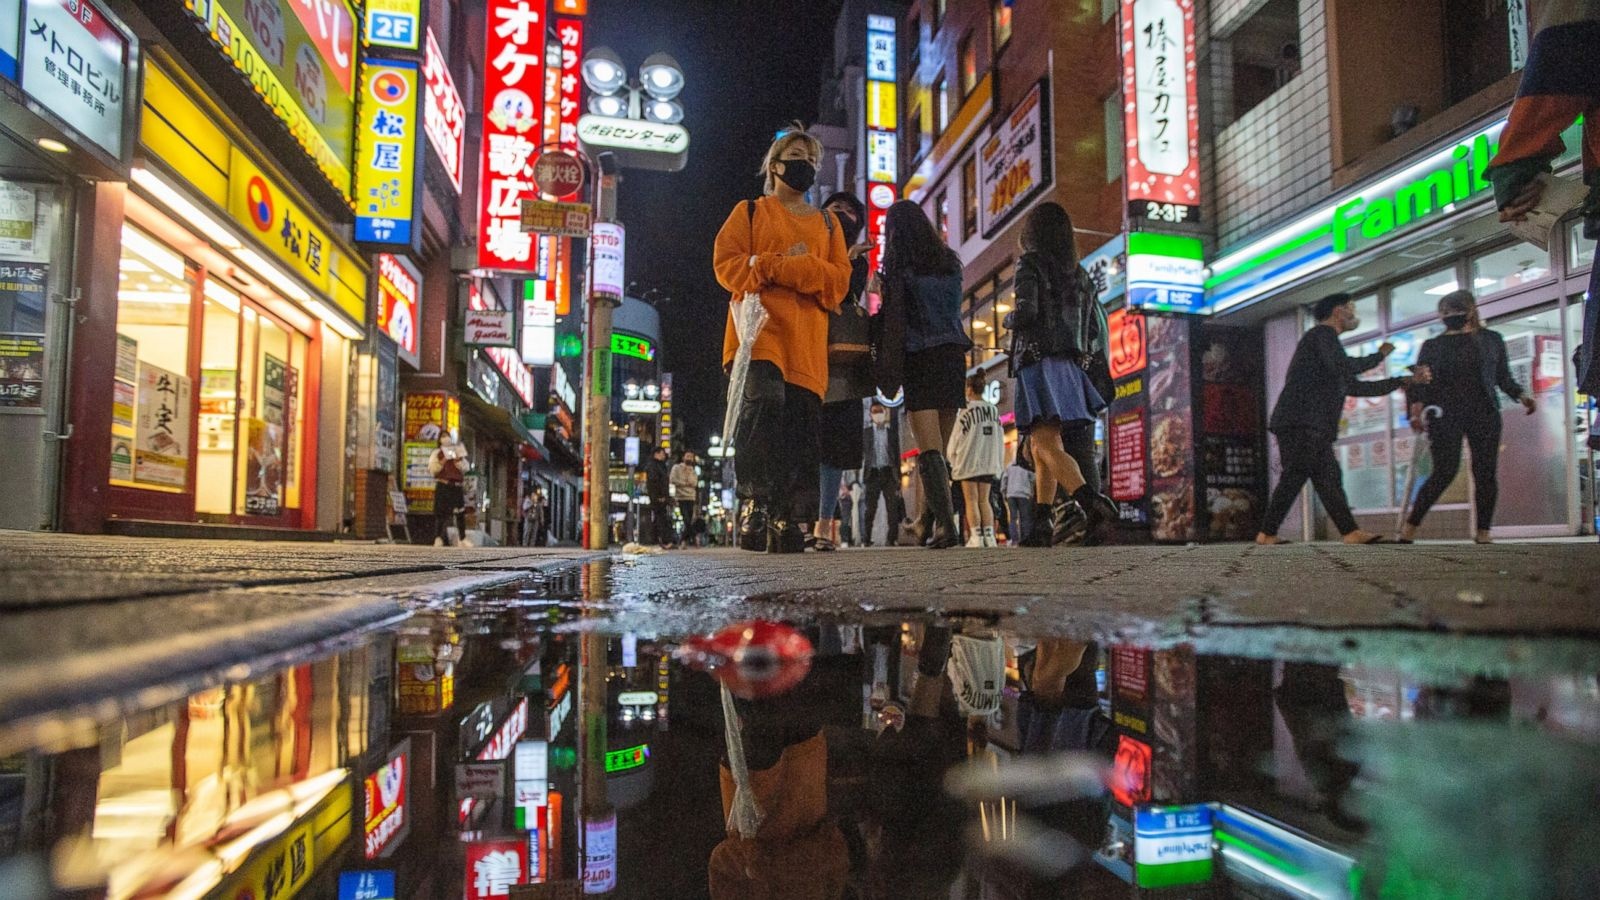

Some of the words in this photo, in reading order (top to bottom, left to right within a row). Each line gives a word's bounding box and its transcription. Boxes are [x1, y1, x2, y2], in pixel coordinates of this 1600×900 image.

[375, 16, 409, 38] 2F
[491, 0, 539, 87] オケ
[30, 18, 120, 103] メトロビル
[45, 56, 105, 117] 管理事務所
[372, 108, 404, 170] 松屋
[583, 123, 682, 144] 渋谷センター街
[537, 164, 579, 184] 消火栓
[486, 133, 534, 261] 歌広場
[1333, 133, 1500, 254] Famil
[281, 207, 323, 276] 松屋
[593, 234, 620, 247] STOP
[1149, 262, 1199, 276] FamilyMart
[467, 318, 503, 328] Miami
[472, 330, 511, 342] Garden
[407, 396, 443, 407] カラオケ
